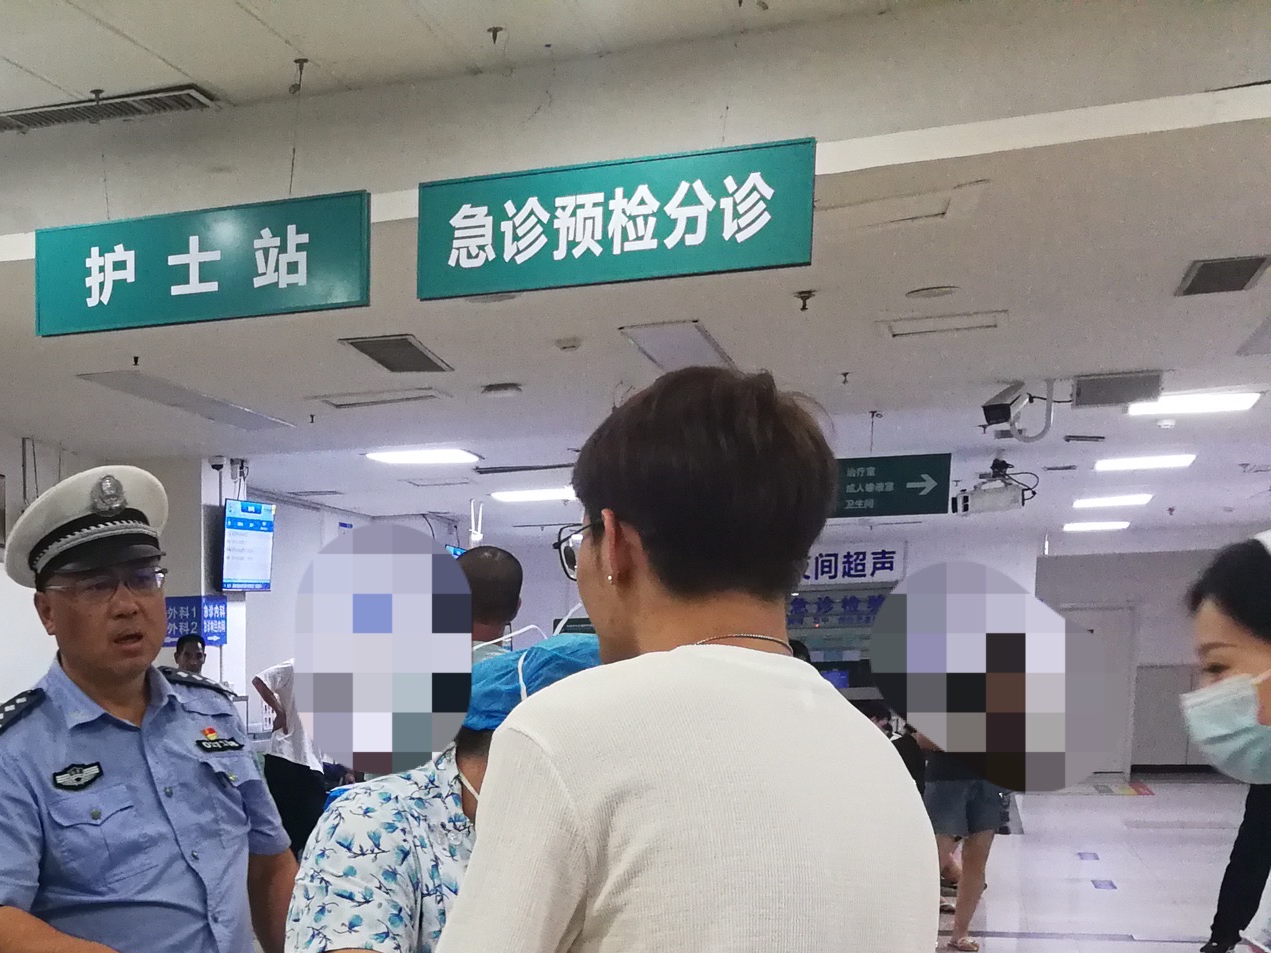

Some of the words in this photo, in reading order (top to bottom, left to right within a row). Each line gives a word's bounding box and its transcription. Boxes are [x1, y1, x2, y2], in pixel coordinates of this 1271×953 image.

[446, 171, 776, 270] 急诊预检分诊
[84, 224, 309, 308] 护士站
[844, 498, 874, 509] 卫生间
[801, 550, 896, 580] 间超声
